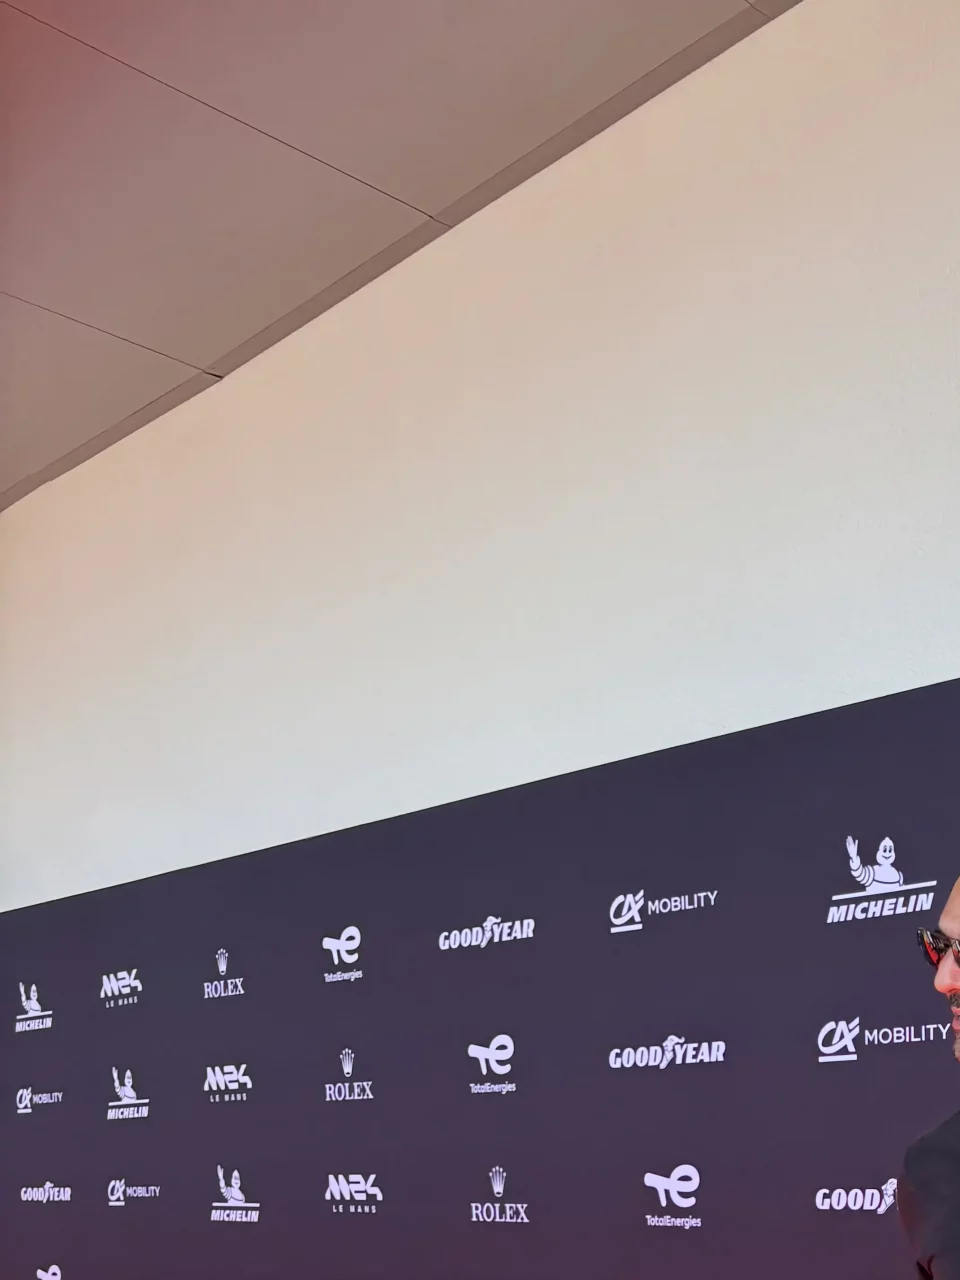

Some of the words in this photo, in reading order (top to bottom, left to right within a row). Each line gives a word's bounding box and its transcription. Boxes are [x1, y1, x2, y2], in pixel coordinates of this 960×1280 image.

[648, 891, 717, 915] MOBILITY
[826, 892, 935, 924] MICHELIN
[439, 916, 535, 950] GOODYEAR
[204, 978, 244, 998] ROLEX
[16, 1018, 52, 1032] MICHELIN
[865, 1023, 950, 1045] MOBILITY
[609, 1035, 725, 1069] GOODYEAR
[325, 1082, 373, 1101] ROLEX
[470, 1081, 516, 1094] TotalEnergies
[33, 1092, 62, 1103] MOBILITY
[225, 1093, 246, 1101] MANS
[107, 1106, 148, 1119] MICHELIN
[21, 1181, 71, 1203] GOODYEAR
[126, 1186, 160, 1197] MOBILITY
[211, 1210, 259, 1222] MICHELIN
[350, 1205, 376, 1213] MANS
[471, 1203, 529, 1222] ROLEX
[645, 1215, 701, 1229] TotalEnergies
